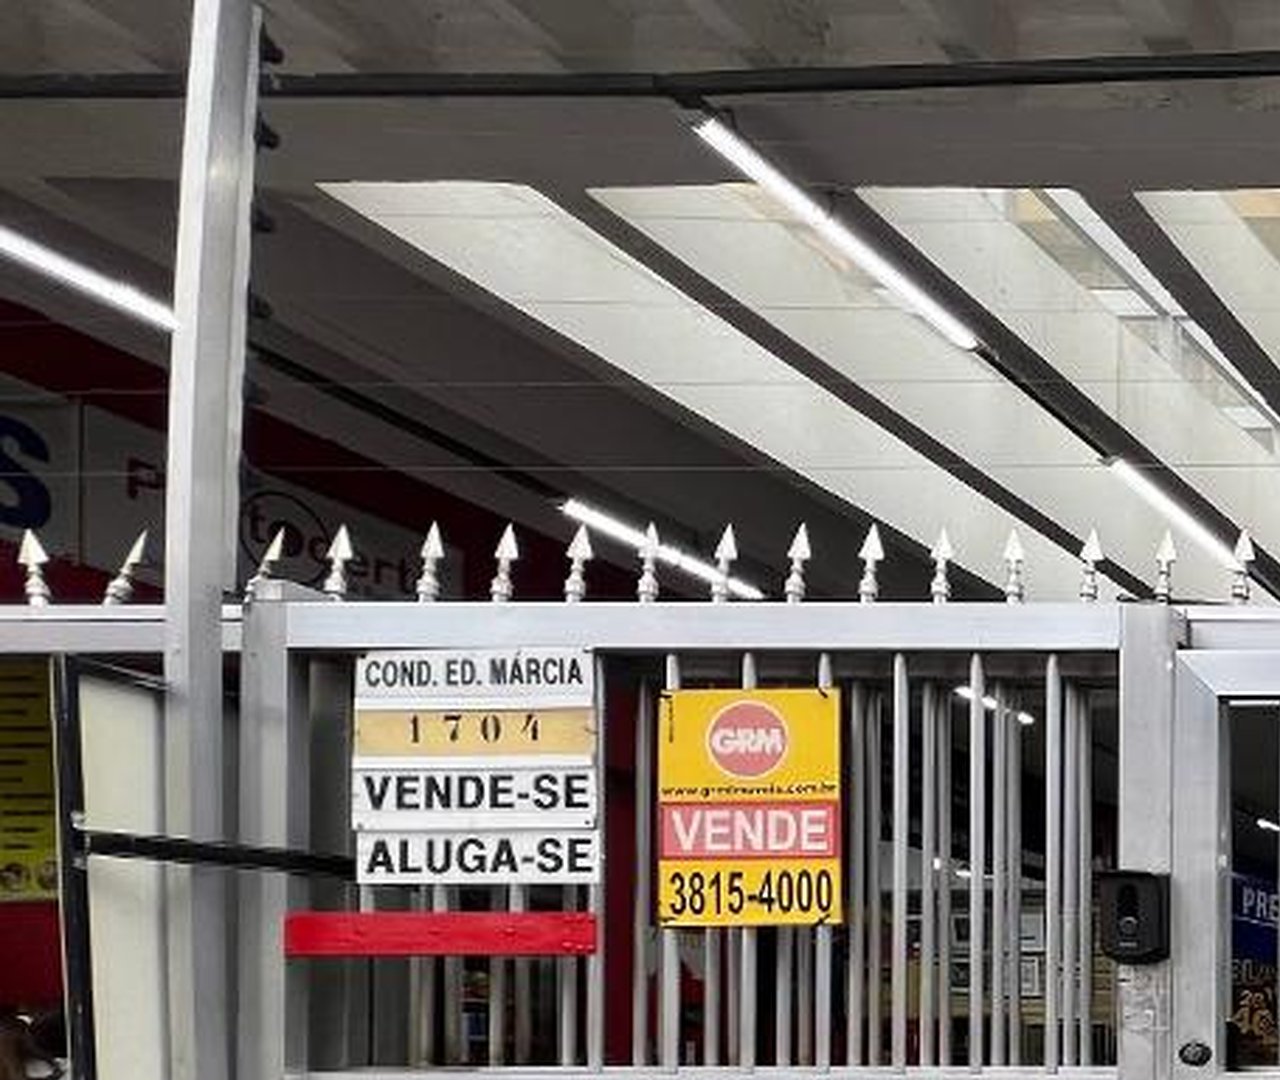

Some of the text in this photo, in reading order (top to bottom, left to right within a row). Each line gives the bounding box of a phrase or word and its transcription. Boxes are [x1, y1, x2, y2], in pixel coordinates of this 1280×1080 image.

[364, 650, 584, 687] COND. ED. MÁRCIA
[410, 713, 540, 744] 1704
[711, 728, 783, 756] GRM
[363, 773, 590, 811] VENDE-SE
[672, 808, 829, 851] VENDE
[365, 837, 594, 874] ALUGA-SE
[669, 868, 833, 915] 3815-4000
